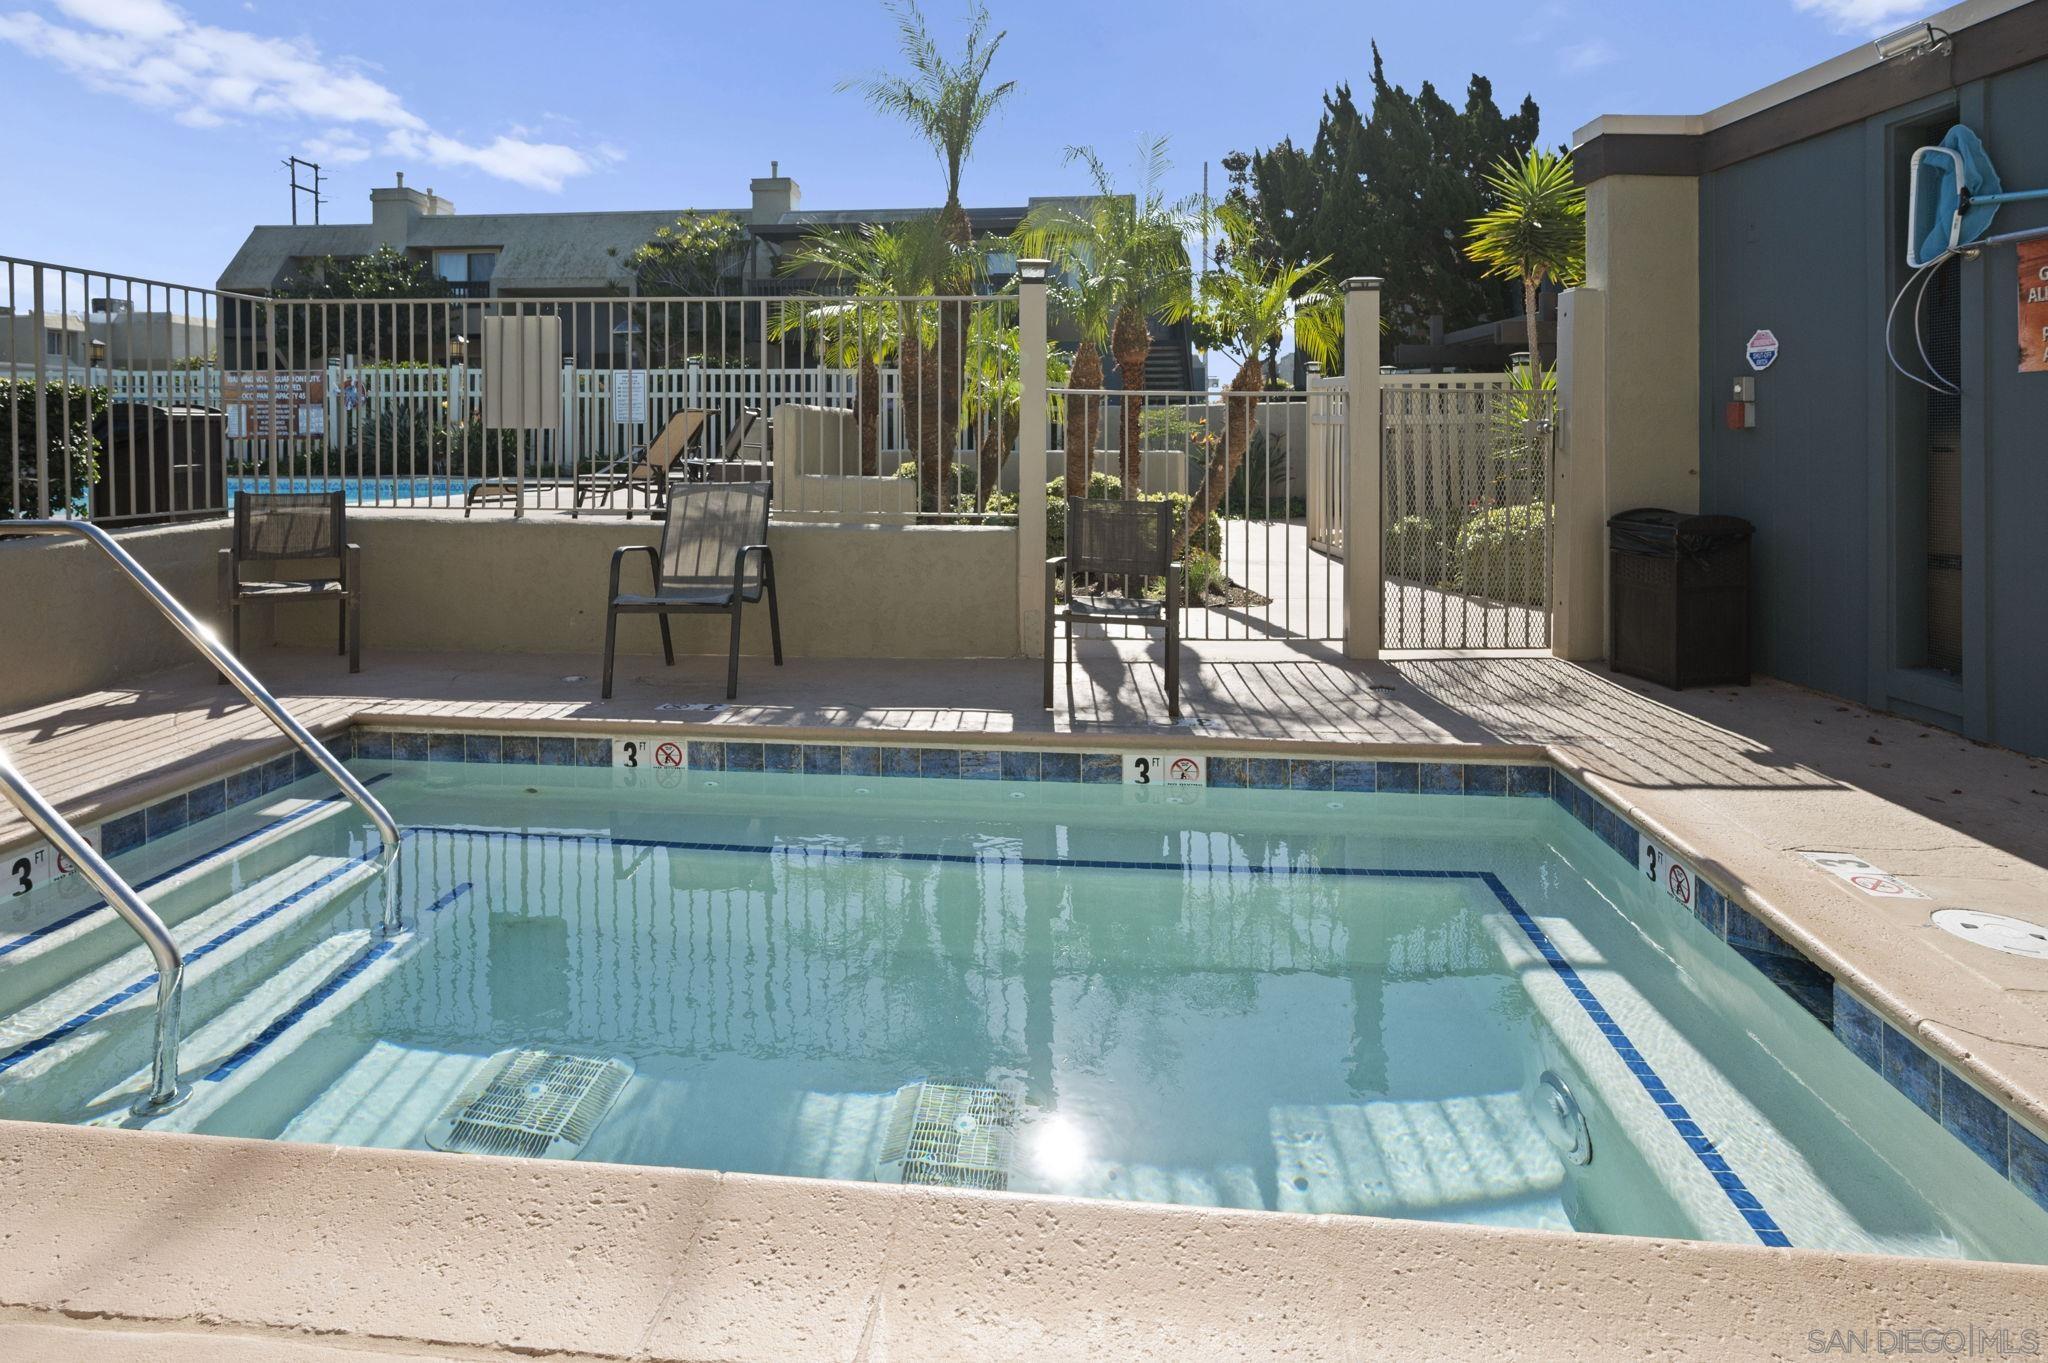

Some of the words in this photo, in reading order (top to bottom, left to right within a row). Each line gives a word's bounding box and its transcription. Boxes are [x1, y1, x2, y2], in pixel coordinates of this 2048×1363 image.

[624, 741, 638, 768] 3
[639, 742, 646, 751] FT
[1134, 757, 1151, 785] 3
[1152, 757, 1161, 767] FT
[12, 857, 33, 897] 3
[34, 849, 45, 865] FT
[1646, 844, 1657, 882] 3
[1658, 851, 1663, 865] FT
